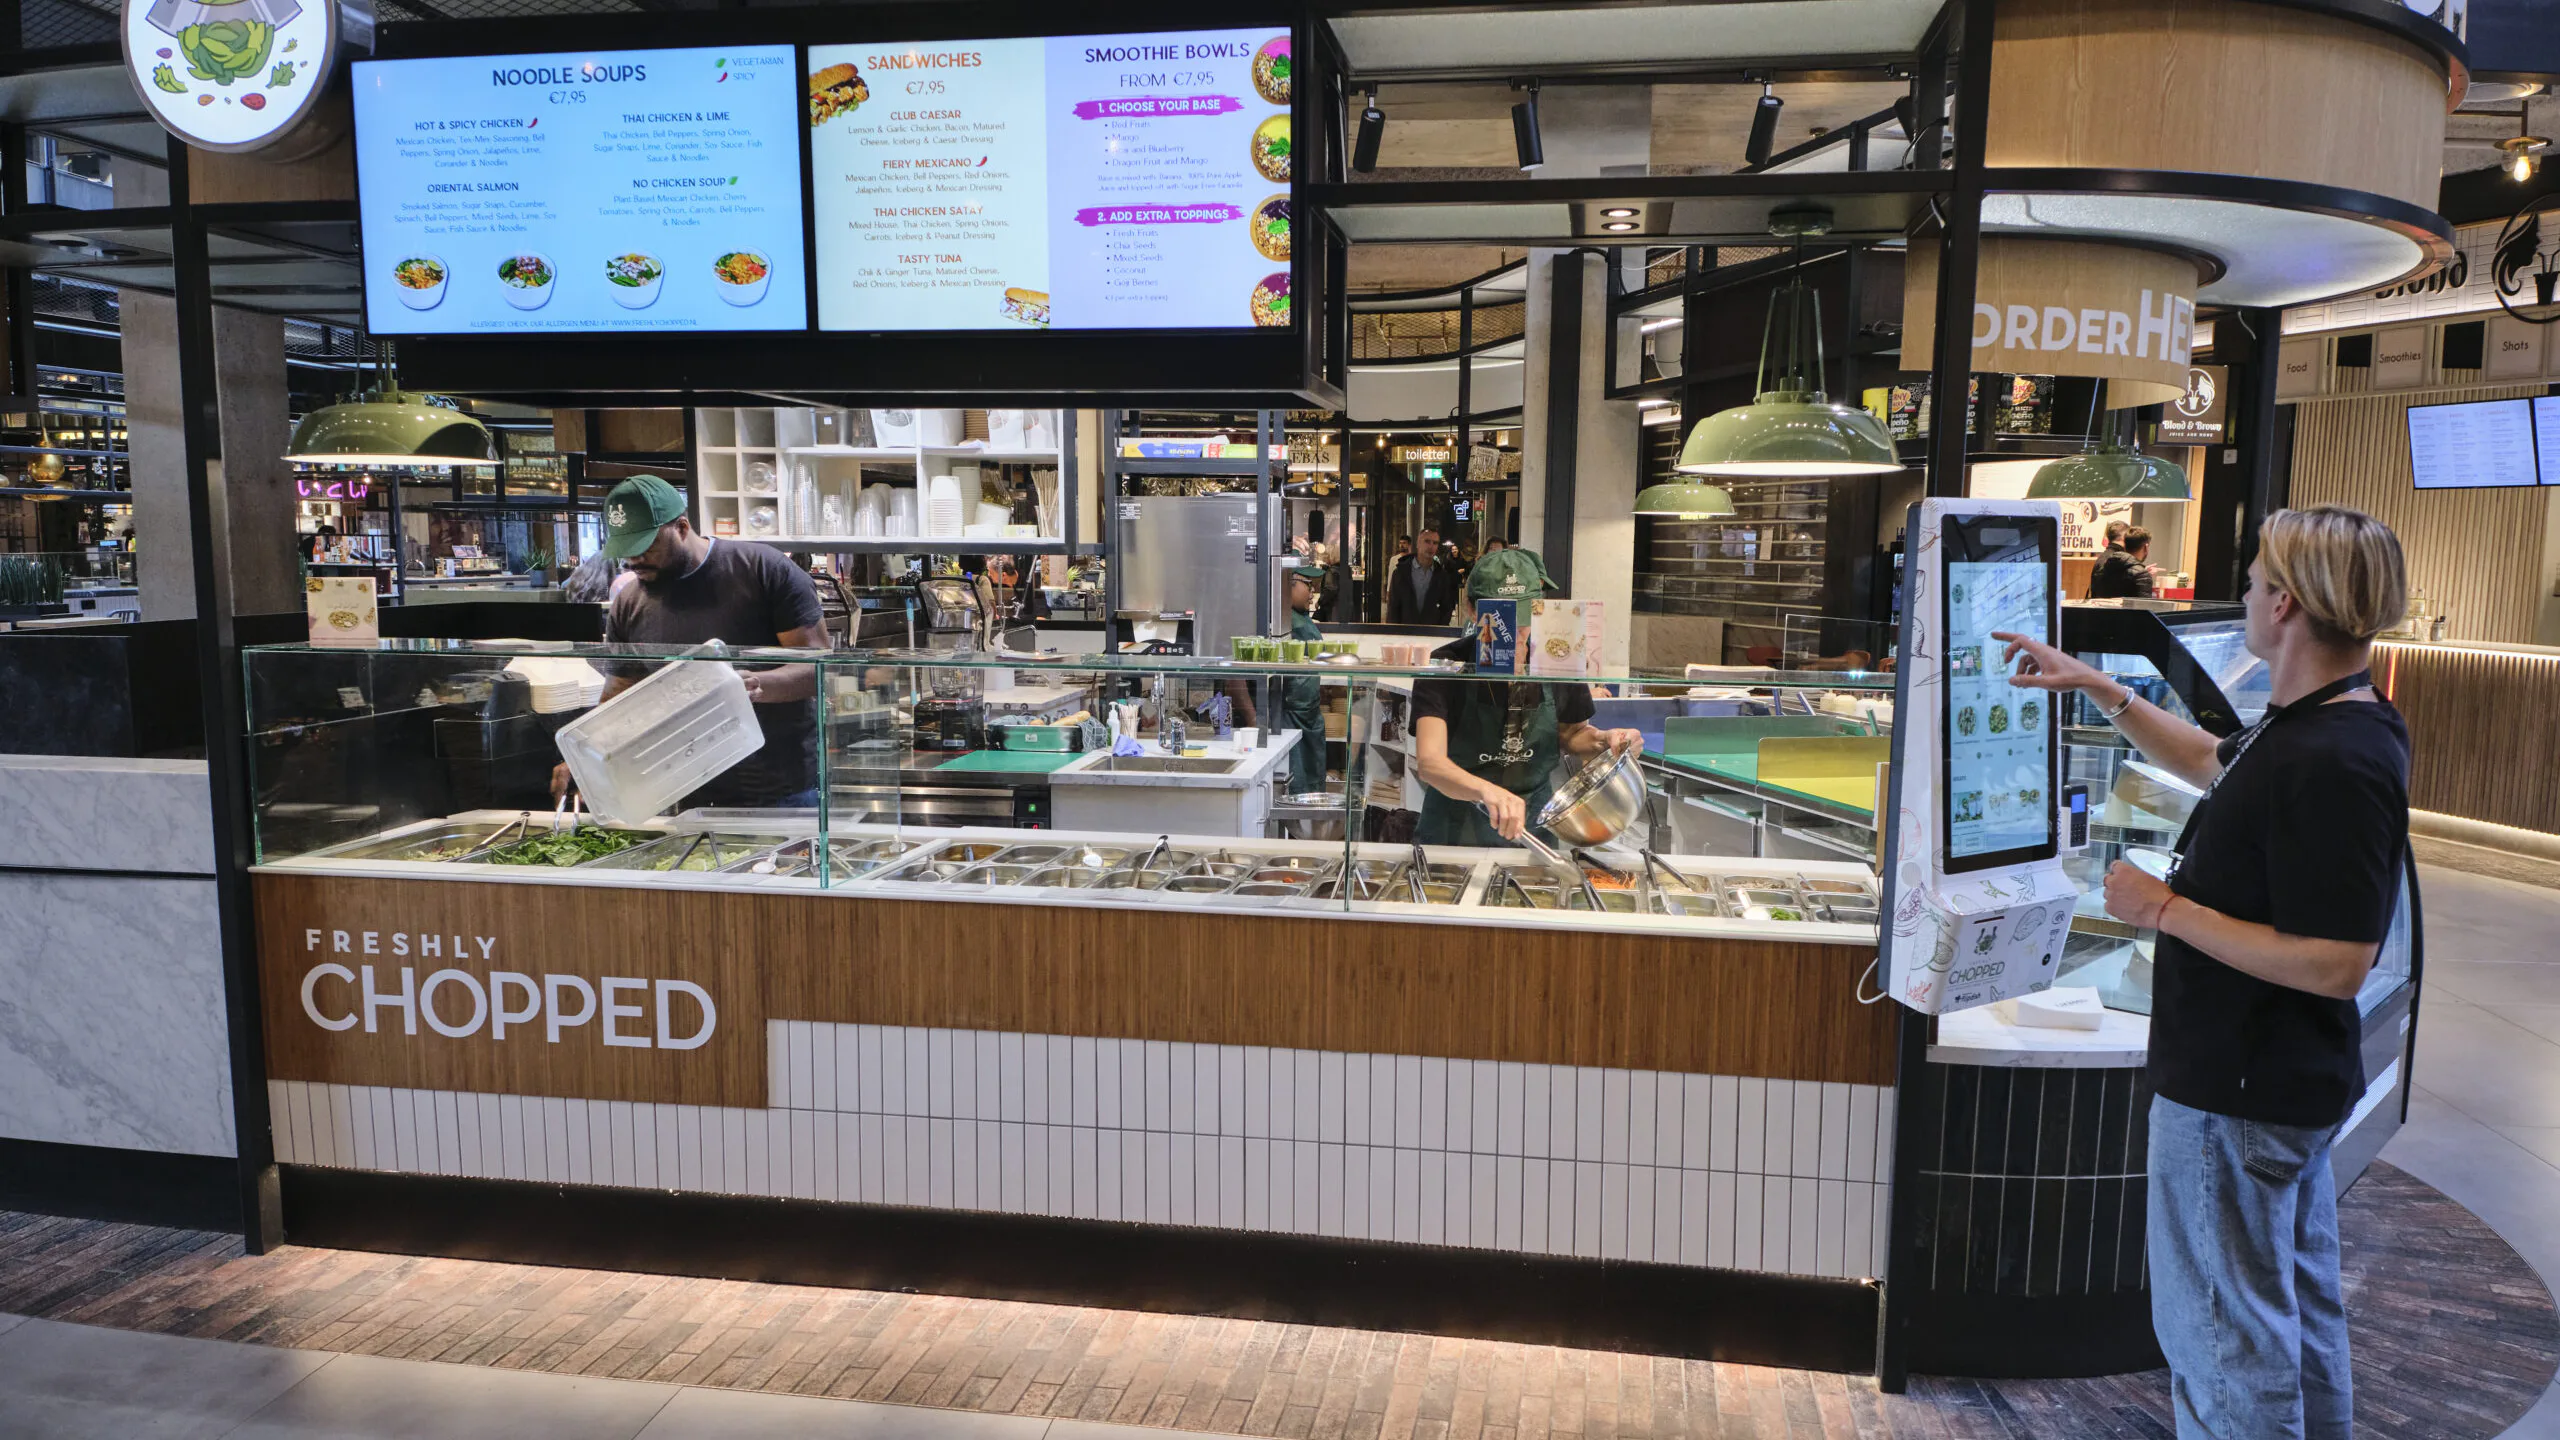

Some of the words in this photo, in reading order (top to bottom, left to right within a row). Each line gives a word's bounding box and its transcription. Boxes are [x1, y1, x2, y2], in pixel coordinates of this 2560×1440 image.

[1085, 45, 1178, 62] SMOOTHIE
[1185, 43, 1250, 59] BOWLS
[732, 56, 784, 66] VEGETARIAN
[868, 52, 982, 70] SANDWICHES
[492, 68, 574, 86] NOODLE
[581, 65, 646, 84] SOUPS
[733, 72, 755, 81] SPICY
[1120, 73, 1166, 87] FROM
[1173, 72, 1214, 87] €7,95
[906, 81, 945, 96] €7,95
[549, 91, 587, 105] €7,95
[1098, 103, 1104, 113] 1.
[1109, 101, 1155, 113] CHOOSE
[1158, 100, 1189, 111] YOUR
[1192, 99, 1220, 110] BASE
[622, 114, 645, 122] THAI
[647, 113, 693, 122] CHICKEN
[695, 113, 703, 121] &
[706, 112, 730, 121] LIME
[890, 111, 917, 120] CLUB
[920, 110, 961, 119] CAESAR
[415, 122, 434, 130] HOT
[438, 121, 446, 129] &
[449, 121, 476, 129] SPICY
[480, 119, 524, 128] CHICKEN
[882, 160, 911, 169] FIERY
[915, 159, 972, 168] MEXICANO
[427, 184, 473, 192] ORIENTAL
[477, 183, 519, 191] SALMON
[632, 179, 649, 187] NO
[651, 178, 696, 187] CHICKEN
[699, 178, 726, 186] SOUP
[874, 208, 897, 216] THAI
[900, 207, 946, 216] CHICKEN
[948, 206, 983, 215] SATAY
[1098, 212, 1106, 222] 2.
[1110, 211, 1132, 222] ADD
[1136, 210, 1170, 221] EXTRA
[1174, 208, 1229, 220] TOPPINGS
[898, 255, 930, 264] TASTY
[934, 255, 962, 263] TUNA
[1970, 303, 2132, 356] ORDER
[2136, 289, 2195, 365] HE
[2502, 341, 2529, 352] Shots
[2379, 351, 2422, 364] Smoothies
[2286, 363, 2307, 373] Food
[2162, 420, 2186, 430] Blond
[2187, 421, 2194, 430] &
[2195, 421, 2222, 432] Brown
[1406, 449, 1450, 460] toiletten
[1491, 610, 1511, 643] THRIVE
[306, 928, 496, 959] FRESHLY
[1949, 961, 2005, 984] CHOPPED
[301, 963, 716, 1050] CHOPPED
